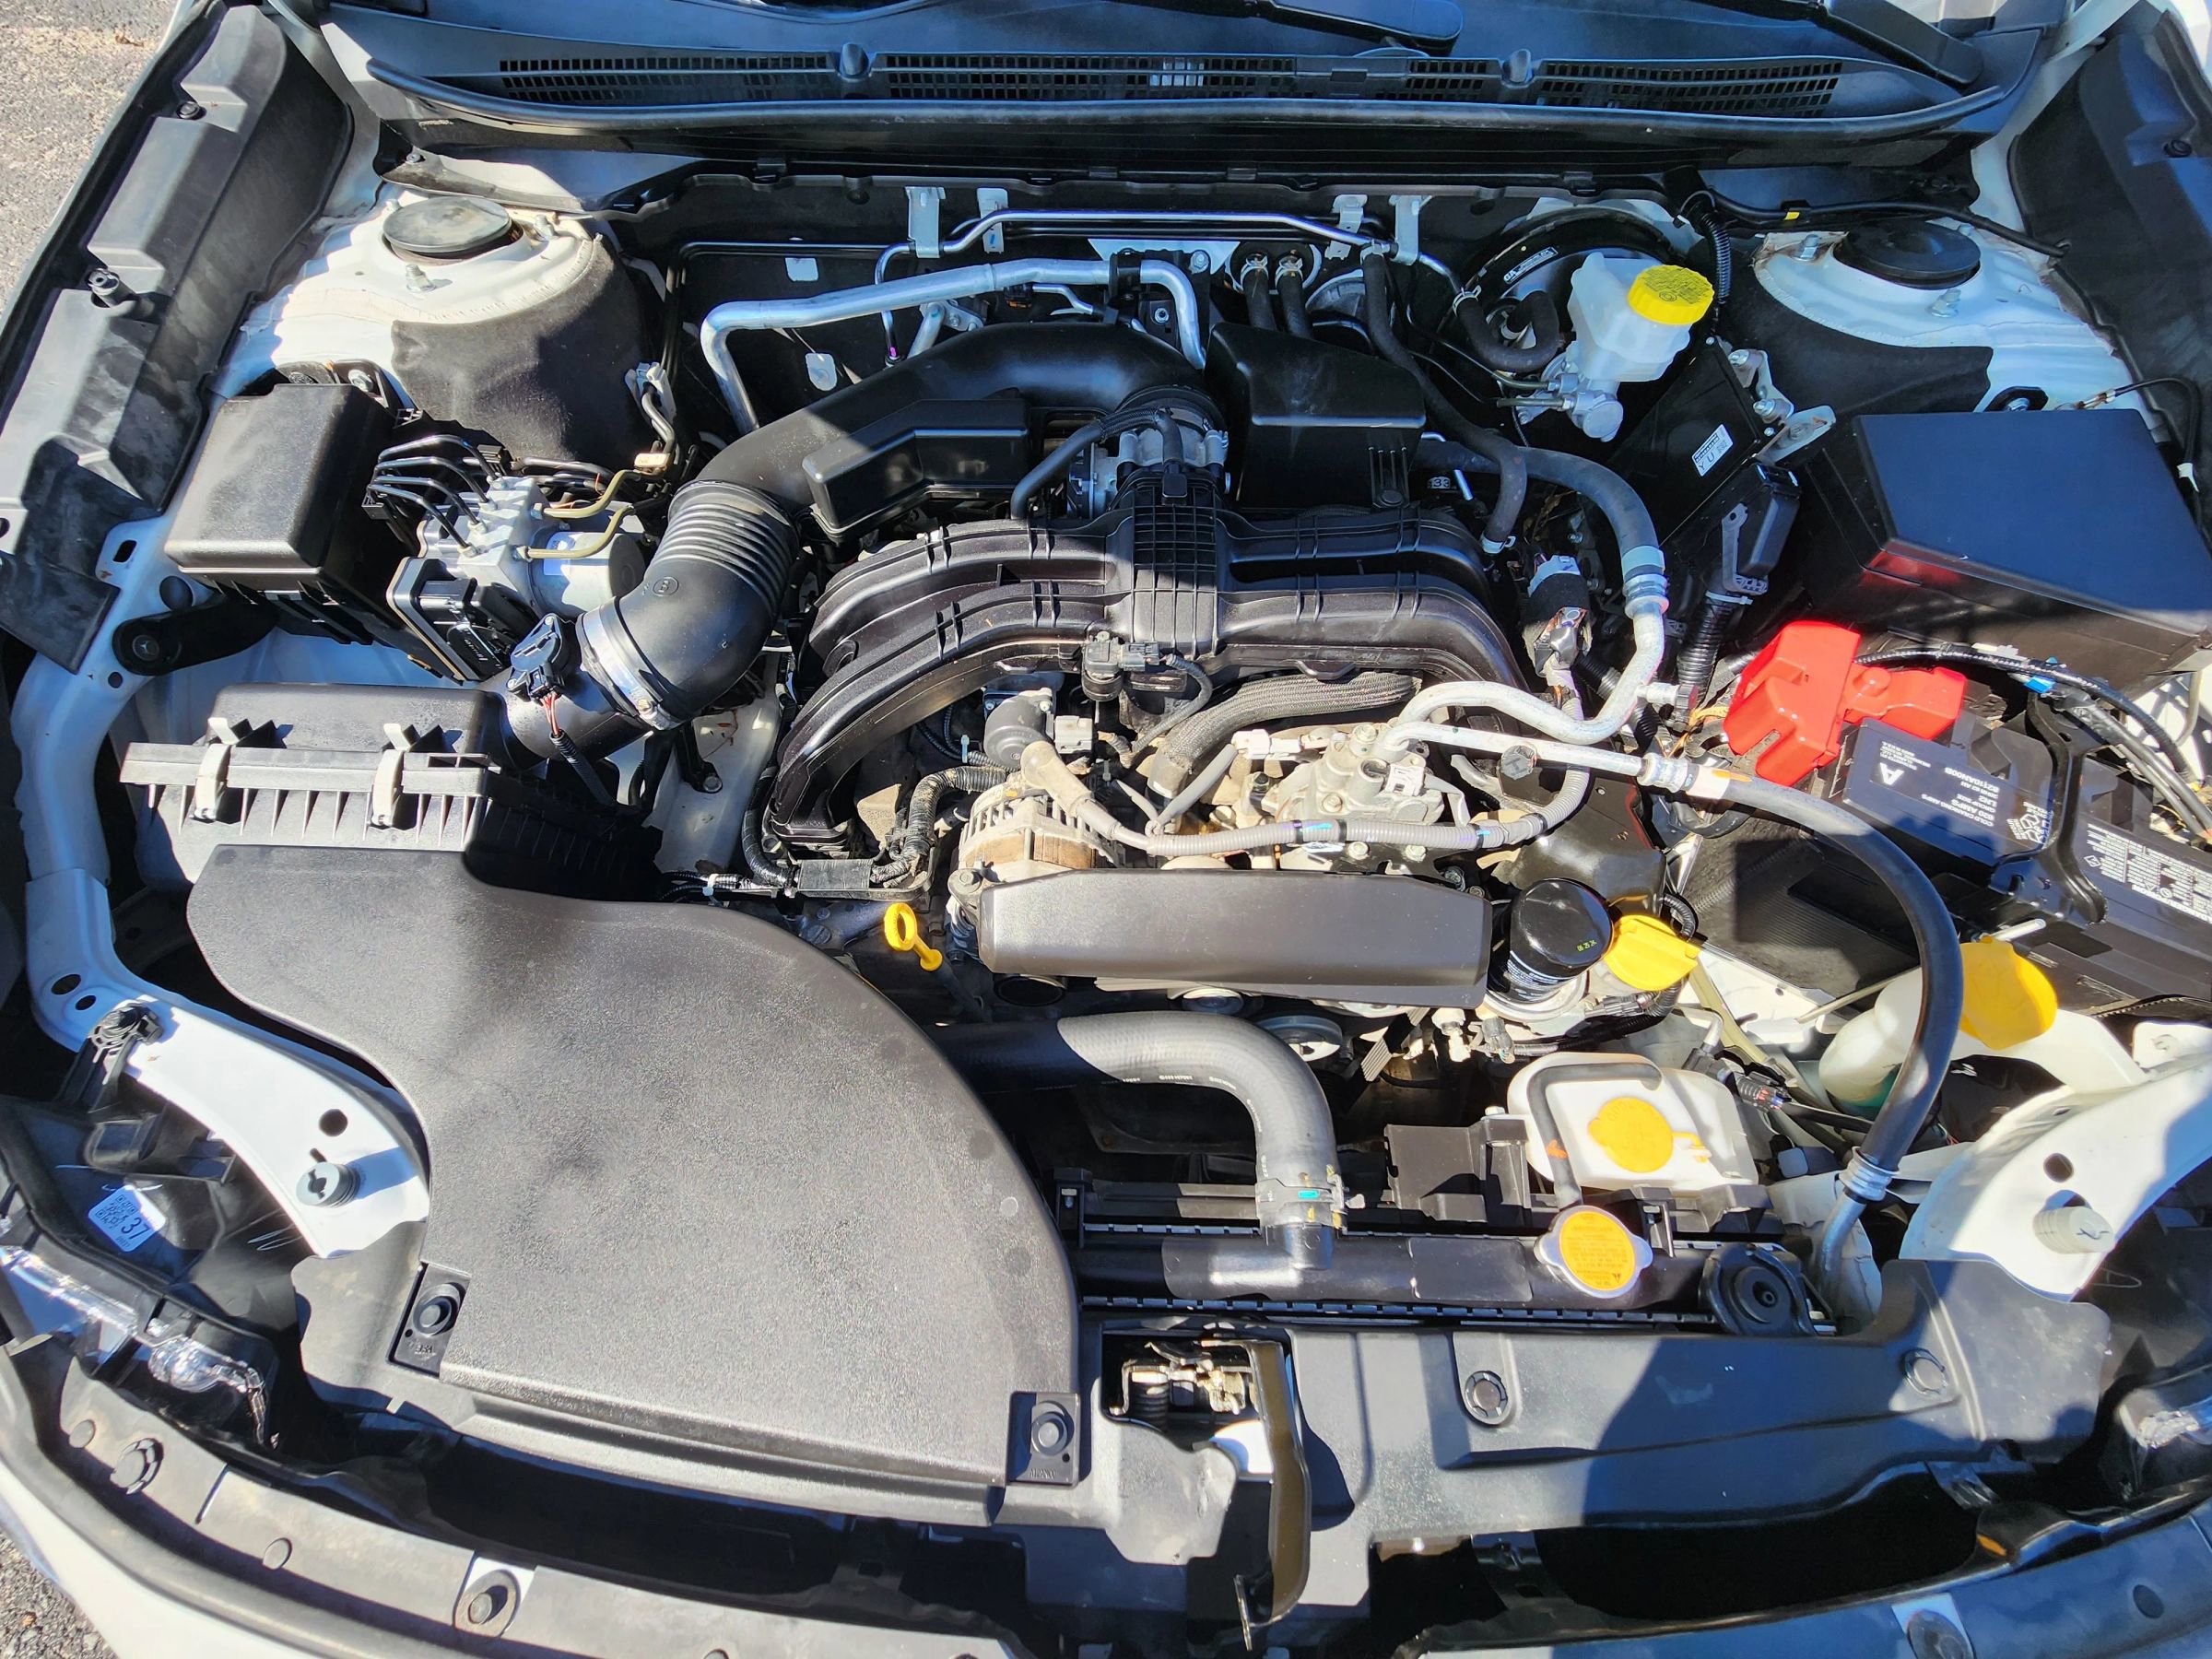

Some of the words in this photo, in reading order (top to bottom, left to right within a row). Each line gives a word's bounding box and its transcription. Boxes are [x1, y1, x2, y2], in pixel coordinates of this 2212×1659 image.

[1921, 794, 1940, 805] AMPS
[1941, 802, 1974, 818] CRANKING
[1950, 799, 1978, 814] AMPS
[1972, 801, 1995, 813] GROUP
[1974, 816, 1994, 827] COLD
[1978, 810, 1994, 821] 620
[121, 1217, 149, 1241] 37
